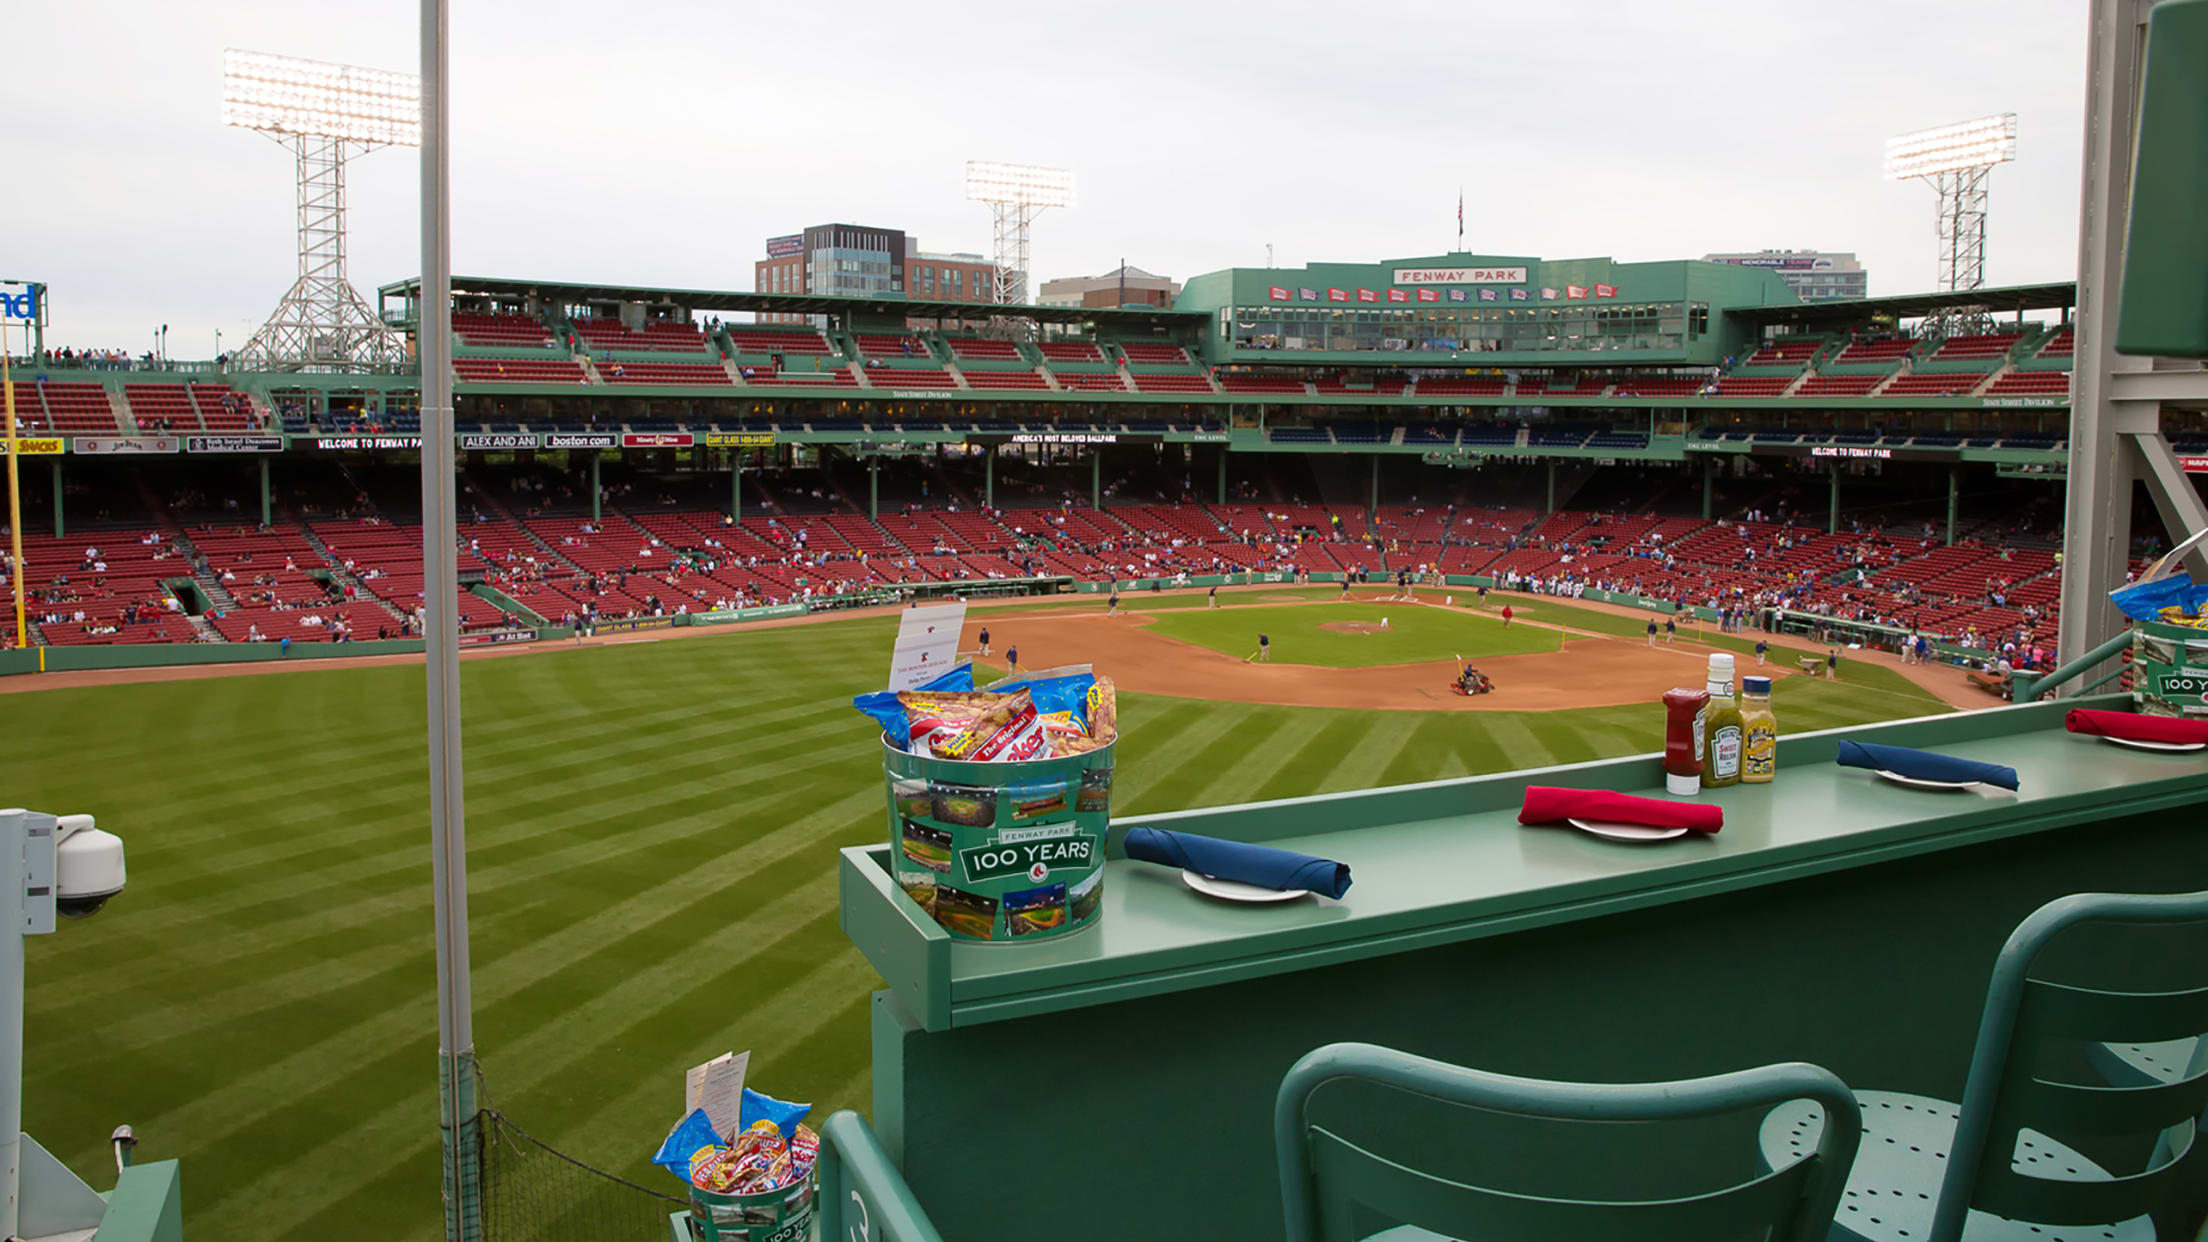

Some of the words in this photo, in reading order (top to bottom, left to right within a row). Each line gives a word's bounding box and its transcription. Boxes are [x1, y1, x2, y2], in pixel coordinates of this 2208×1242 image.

[1402, 271, 1465, 282] FENWAY
[1474, 270, 1517, 281] PARK
[318, 438, 358, 449] WELCOME
[361, 439, 373, 448] TO
[375, 438, 409, 449] FENWAY
[466, 436, 491, 447] ALEX
[493, 436, 516, 447] AND
[516, 436, 535, 446] ANI
[1012, 434, 1044, 443] AMERICA'S
[1044, 434, 1060, 443] MOST
[1061, 434, 1086, 443] BELOVED
[1087, 434, 1117, 443] BALLPARK
[19, 440, 58, 452] SNACKS
[1811, 447, 1838, 456] WELCOME
[1839, 448, 1848, 457] TO
[1848, 448, 1872, 458] FENWAY
[1873, 449, 1891, 458] PARK
[506, 633, 518, 641] At
[518, 632, 532, 640] Bat
[2165, 679, 2193, 690] 100
[982, 743, 998, 757] The
[997, 715, 1028, 744] Original
[1005, 831, 1043, 840] FENWAY
[1047, 828, 1071, 837] PARK
[973, 850, 1018, 871] 100
[1024, 842, 1090, 862] YEARS
